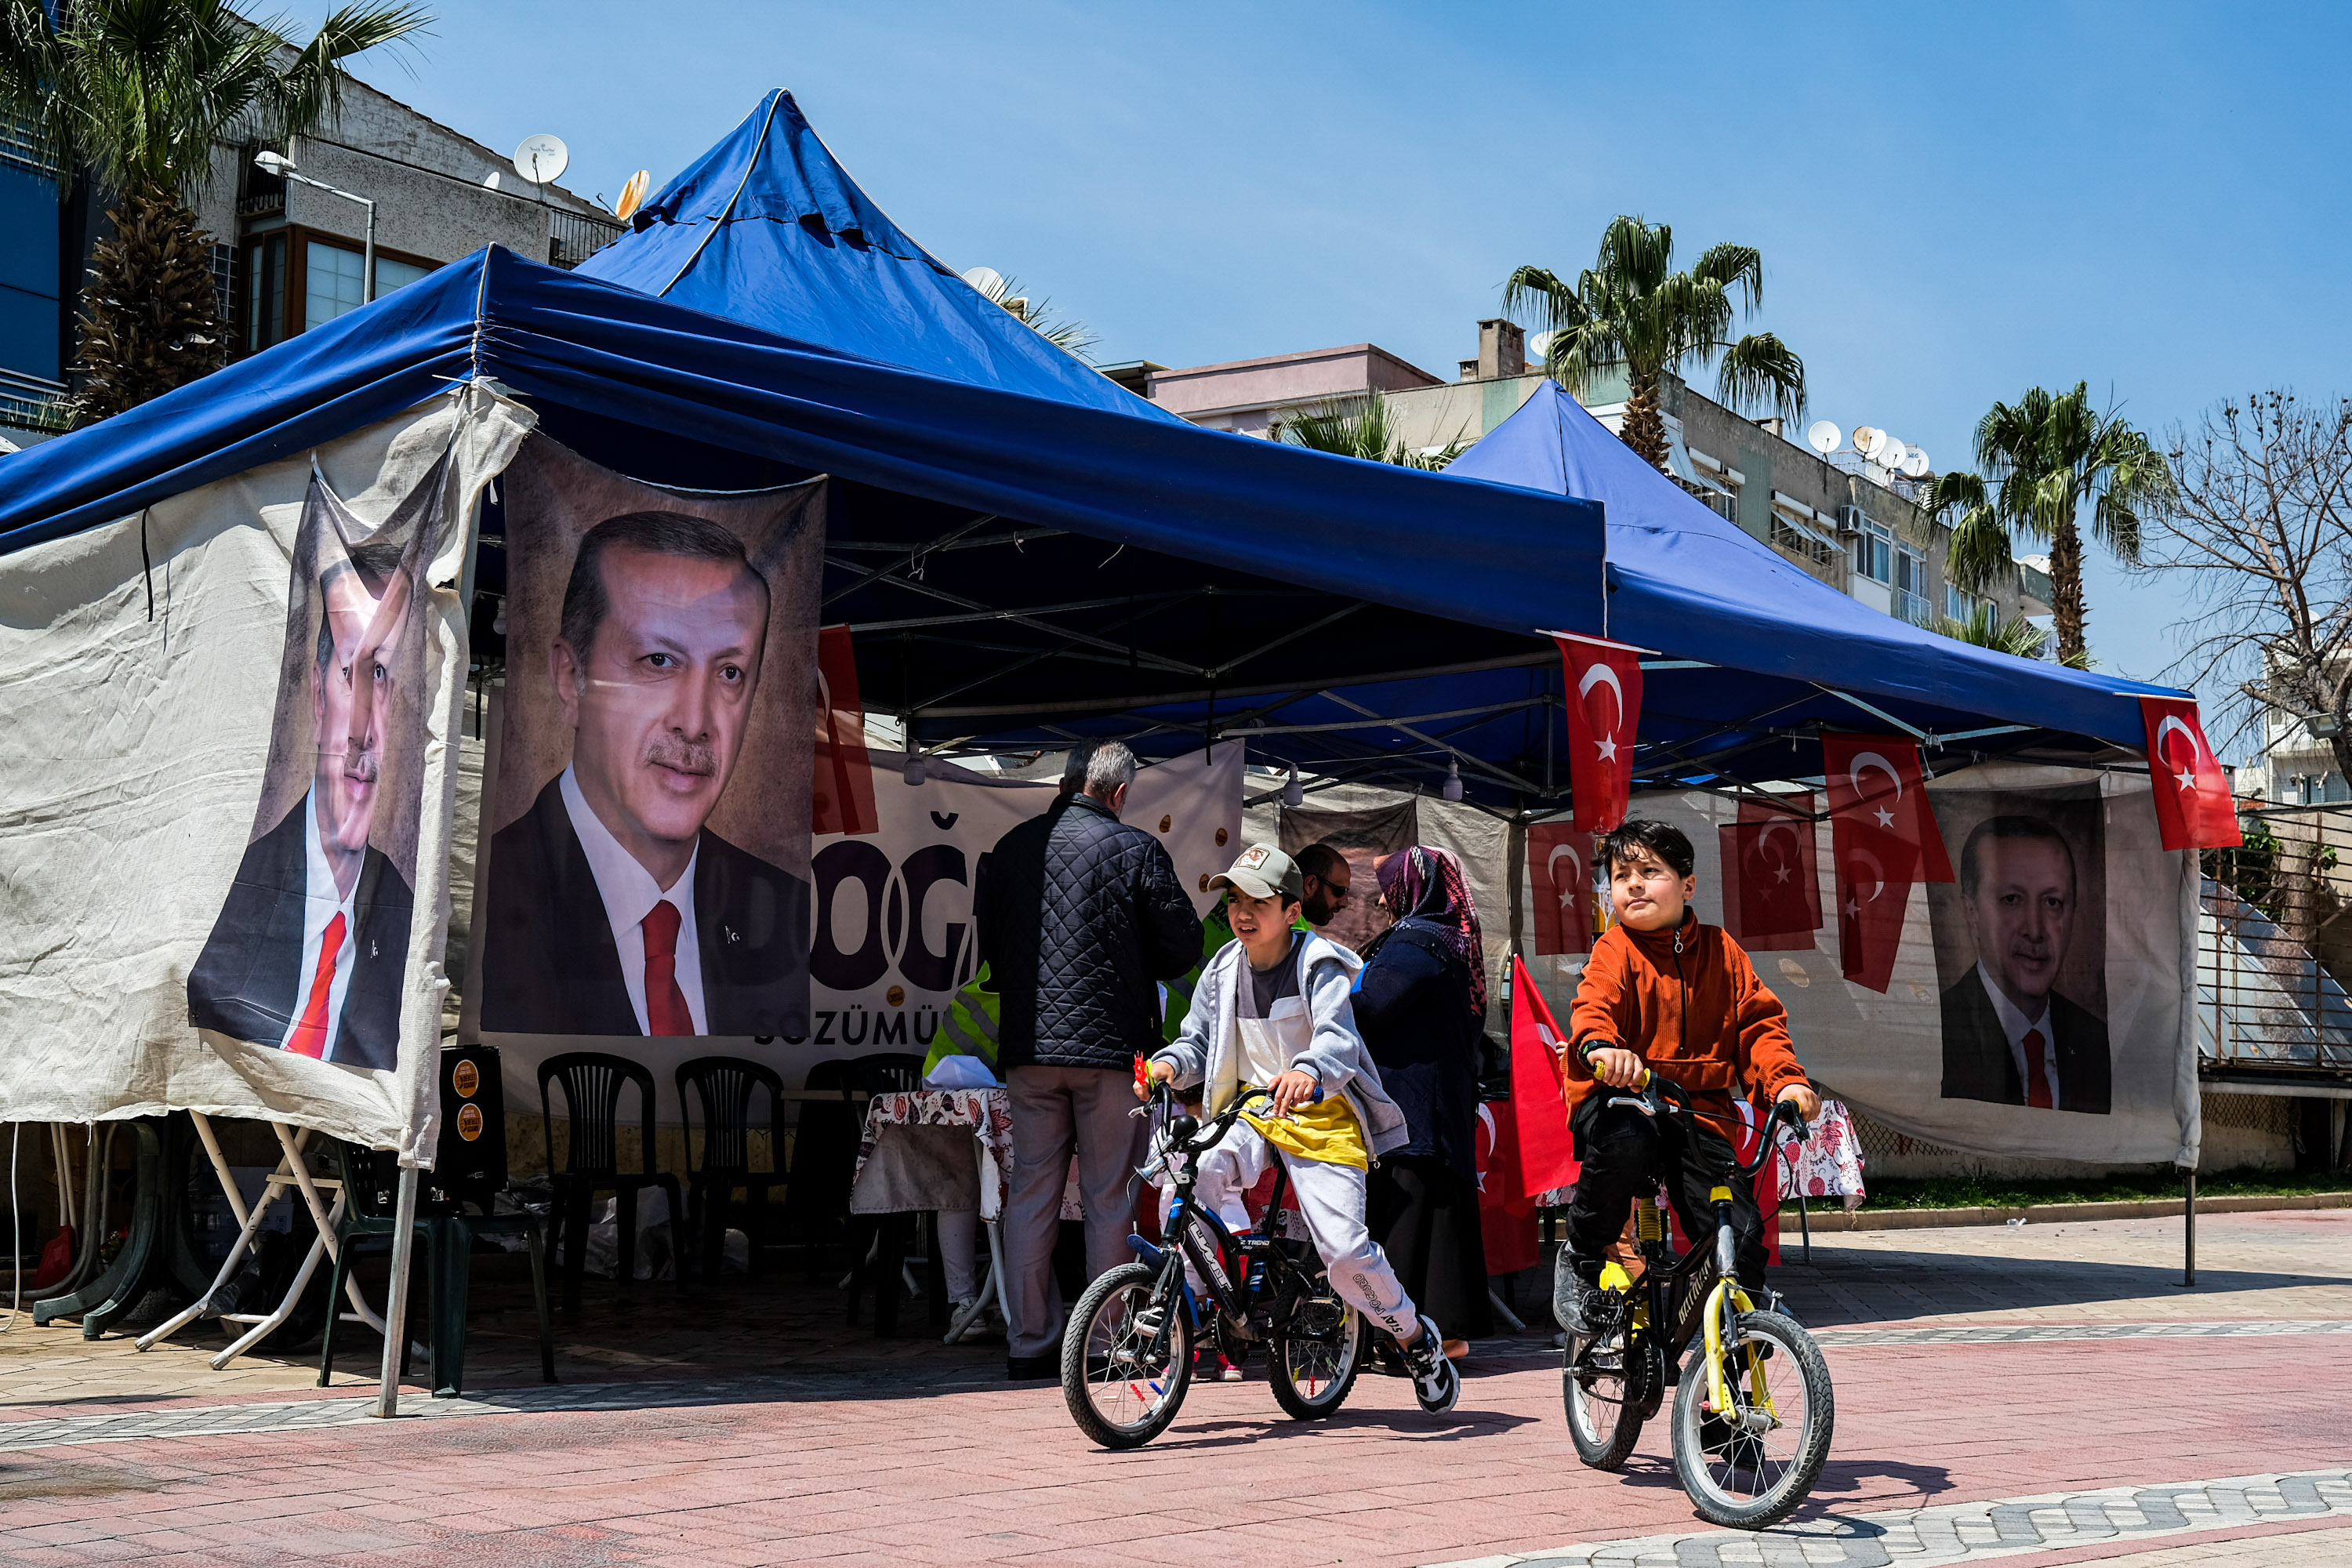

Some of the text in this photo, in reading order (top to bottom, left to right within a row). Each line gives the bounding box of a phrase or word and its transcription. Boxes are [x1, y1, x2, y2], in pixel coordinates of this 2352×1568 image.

[754, 1004, 951, 1046] ZÜMÜ
[1352, 1272, 1403, 1333] STAY FOCUSED
